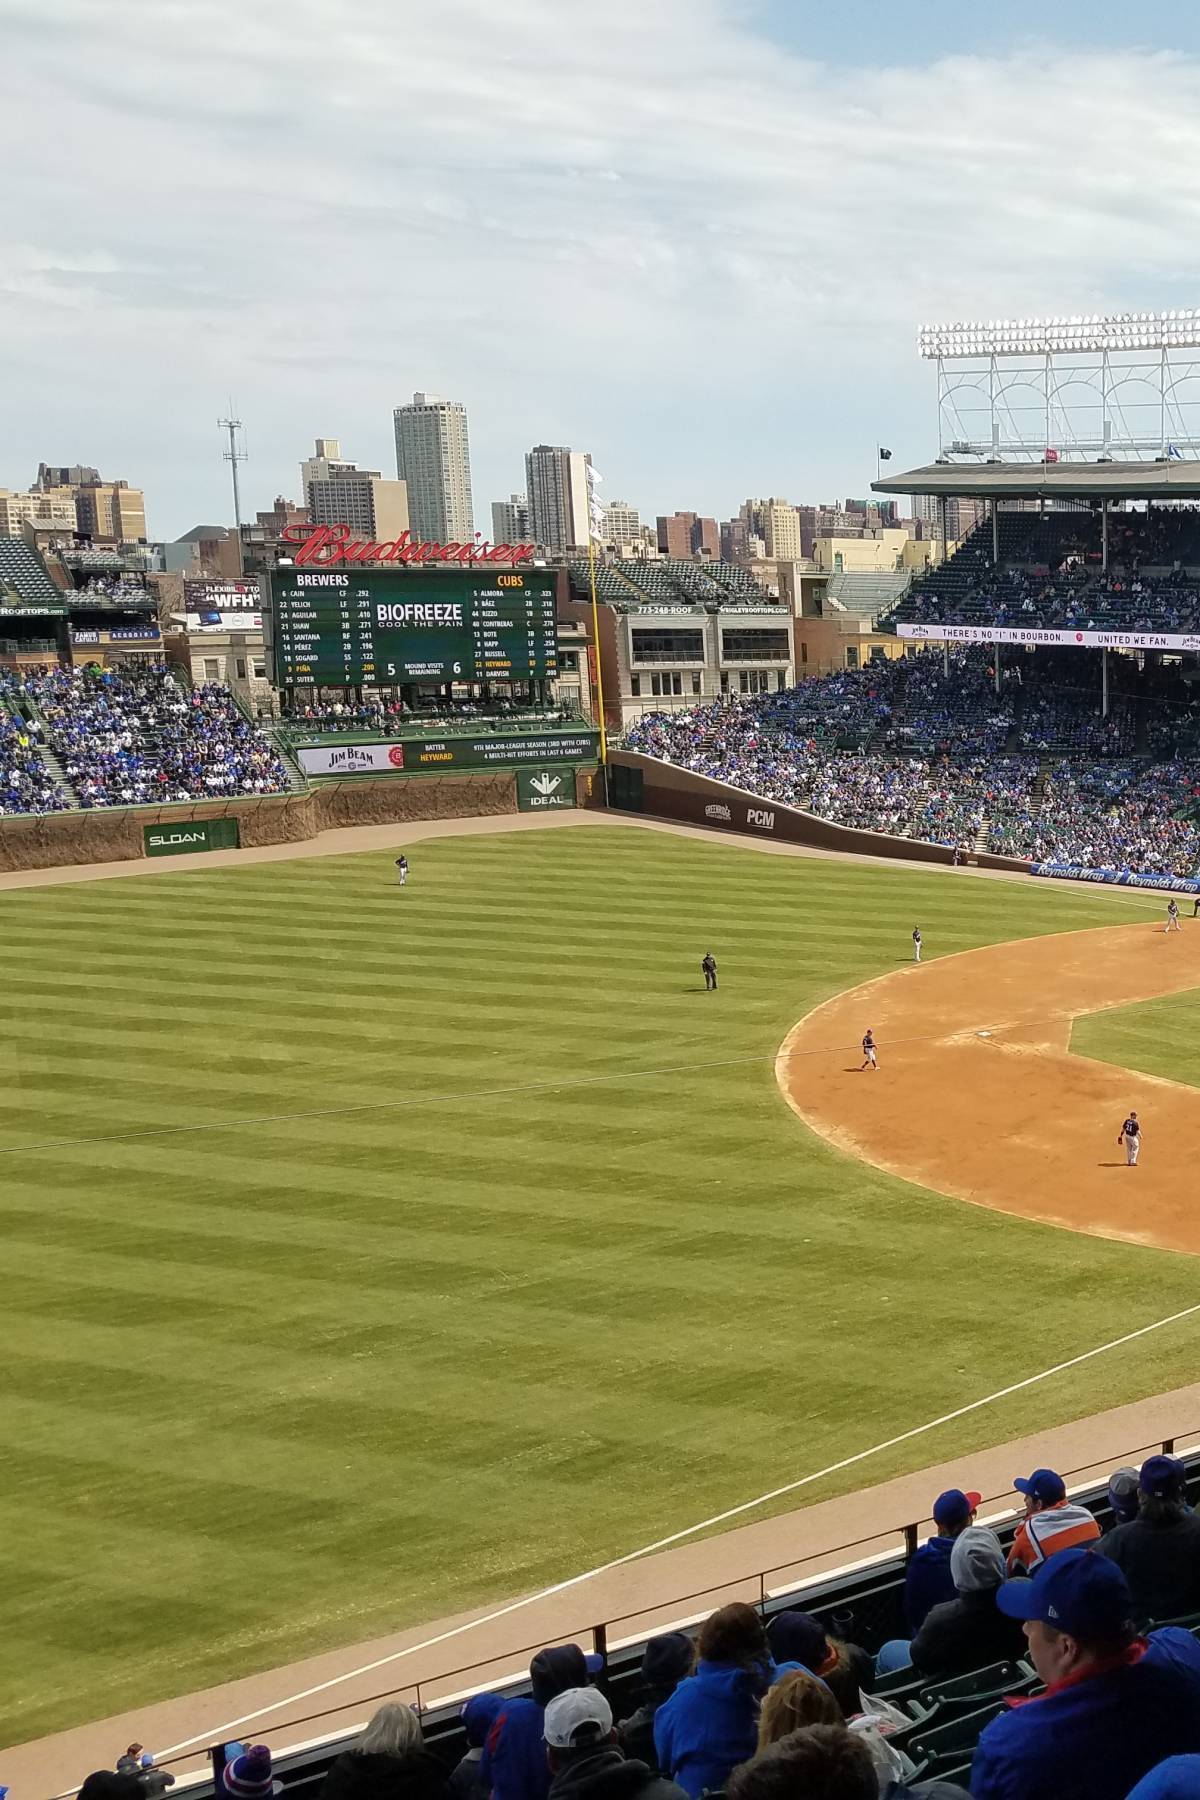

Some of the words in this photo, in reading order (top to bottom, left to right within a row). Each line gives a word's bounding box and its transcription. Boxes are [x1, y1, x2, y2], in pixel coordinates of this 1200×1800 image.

[282, 524, 535, 566] Budweiser
[297, 575, 349, 586] BREWERS
[498, 576, 523, 586] CUBS
[377, 604, 462, 620] BIOFREEZE
[942, 629, 977, 638] THERE'S
[981, 630, 992, 638] NO
[1010, 631, 1018, 639] IN
[1021, 632, 1064, 641] BOURBON.
[1098, 635, 1130, 644] UNITED
[1134, 637, 1145, 645] WE
[1150, 638, 1169, 646] FAN.
[388, 664, 395, 675] 5
[453, 662, 461, 673] 6
[328, 752, 345, 768] JIM
[348, 748, 373, 765] BEAM
[531, 796, 563, 805] IDEAL
[747, 809, 775, 826] PCM
[149, 832, 205, 846] SLOAN
[1037, 864, 1079, 879] Reynolds
[1080, 868, 1104, 882] Wrap
[1126, 873, 1170, 889] Reynolds
[1171, 878, 1198, 893] Wrap
